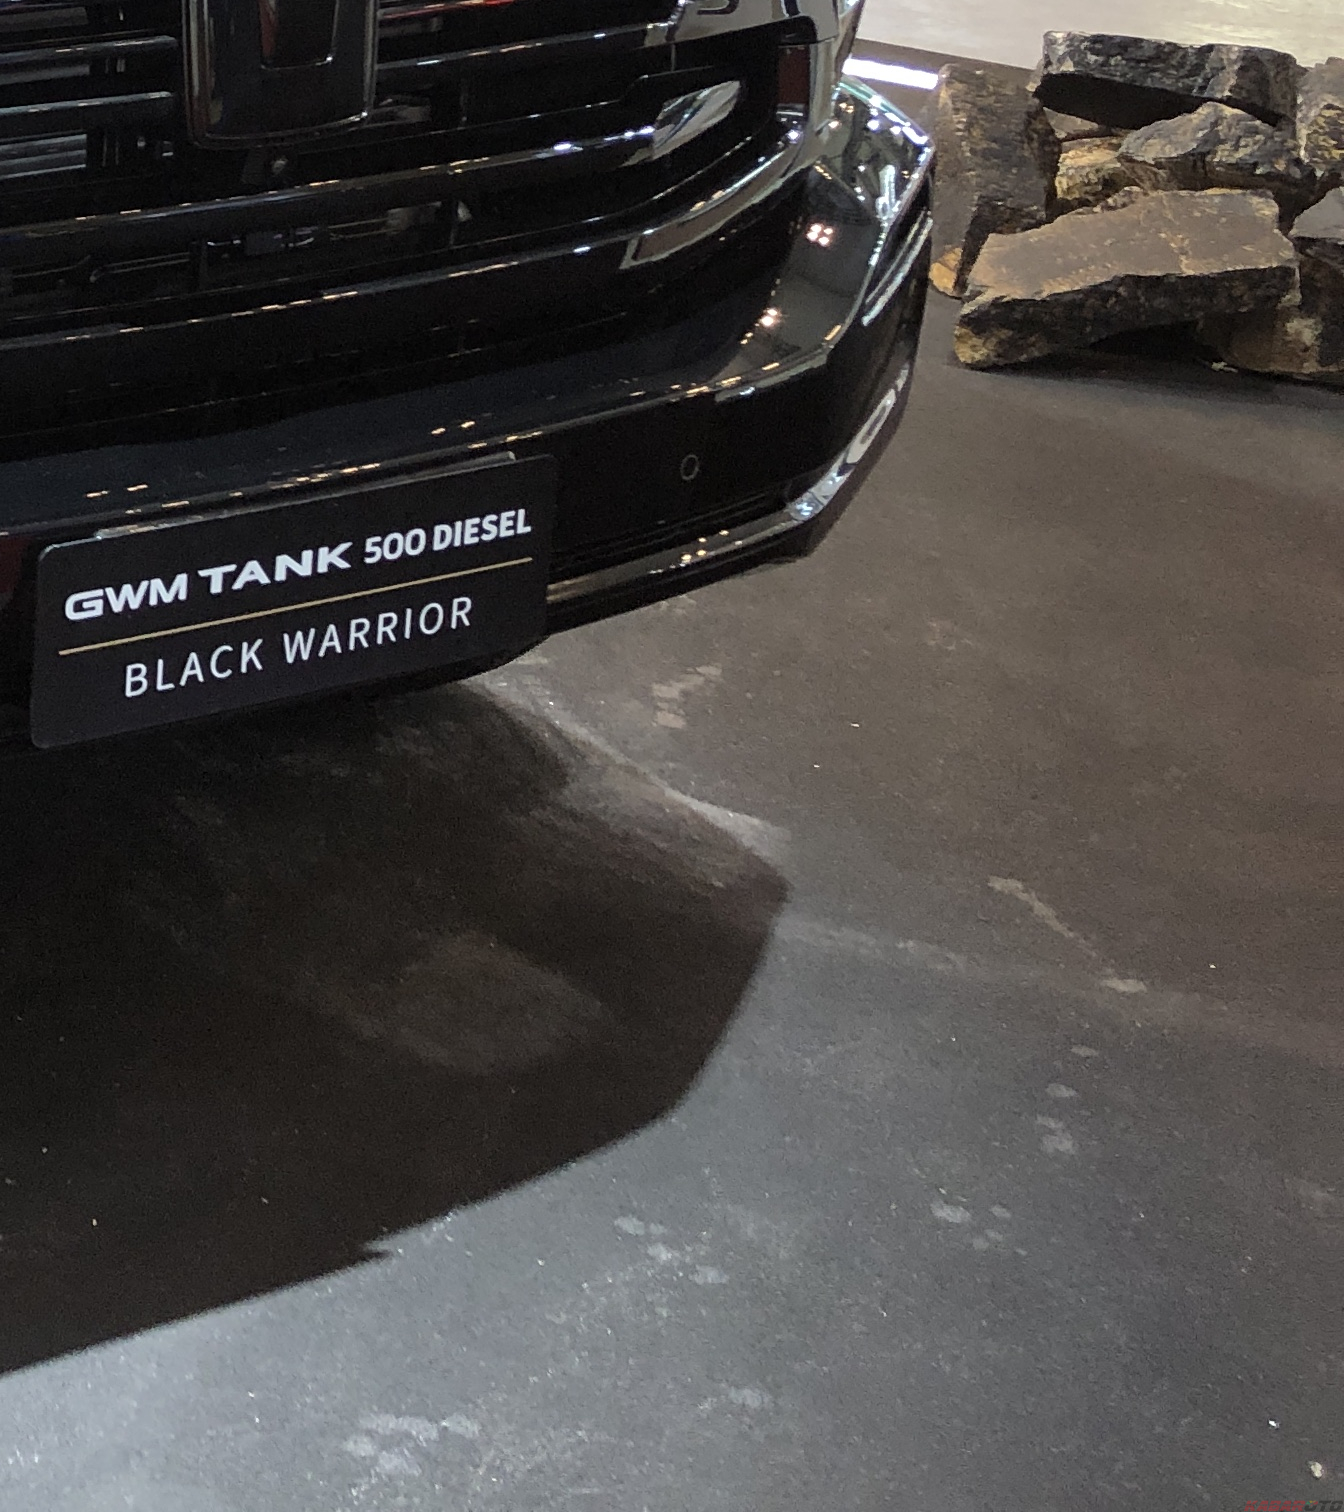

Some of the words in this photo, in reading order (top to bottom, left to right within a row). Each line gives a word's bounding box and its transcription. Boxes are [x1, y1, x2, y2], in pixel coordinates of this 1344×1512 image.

[64, 573, 188, 621] GWM
[198, 541, 353, 595] TANK
[364, 528, 427, 565] 500
[432, 508, 532, 552] DIESEL
[124, 638, 263, 698] BLACK
[282, 596, 472, 665] WARRIOR
